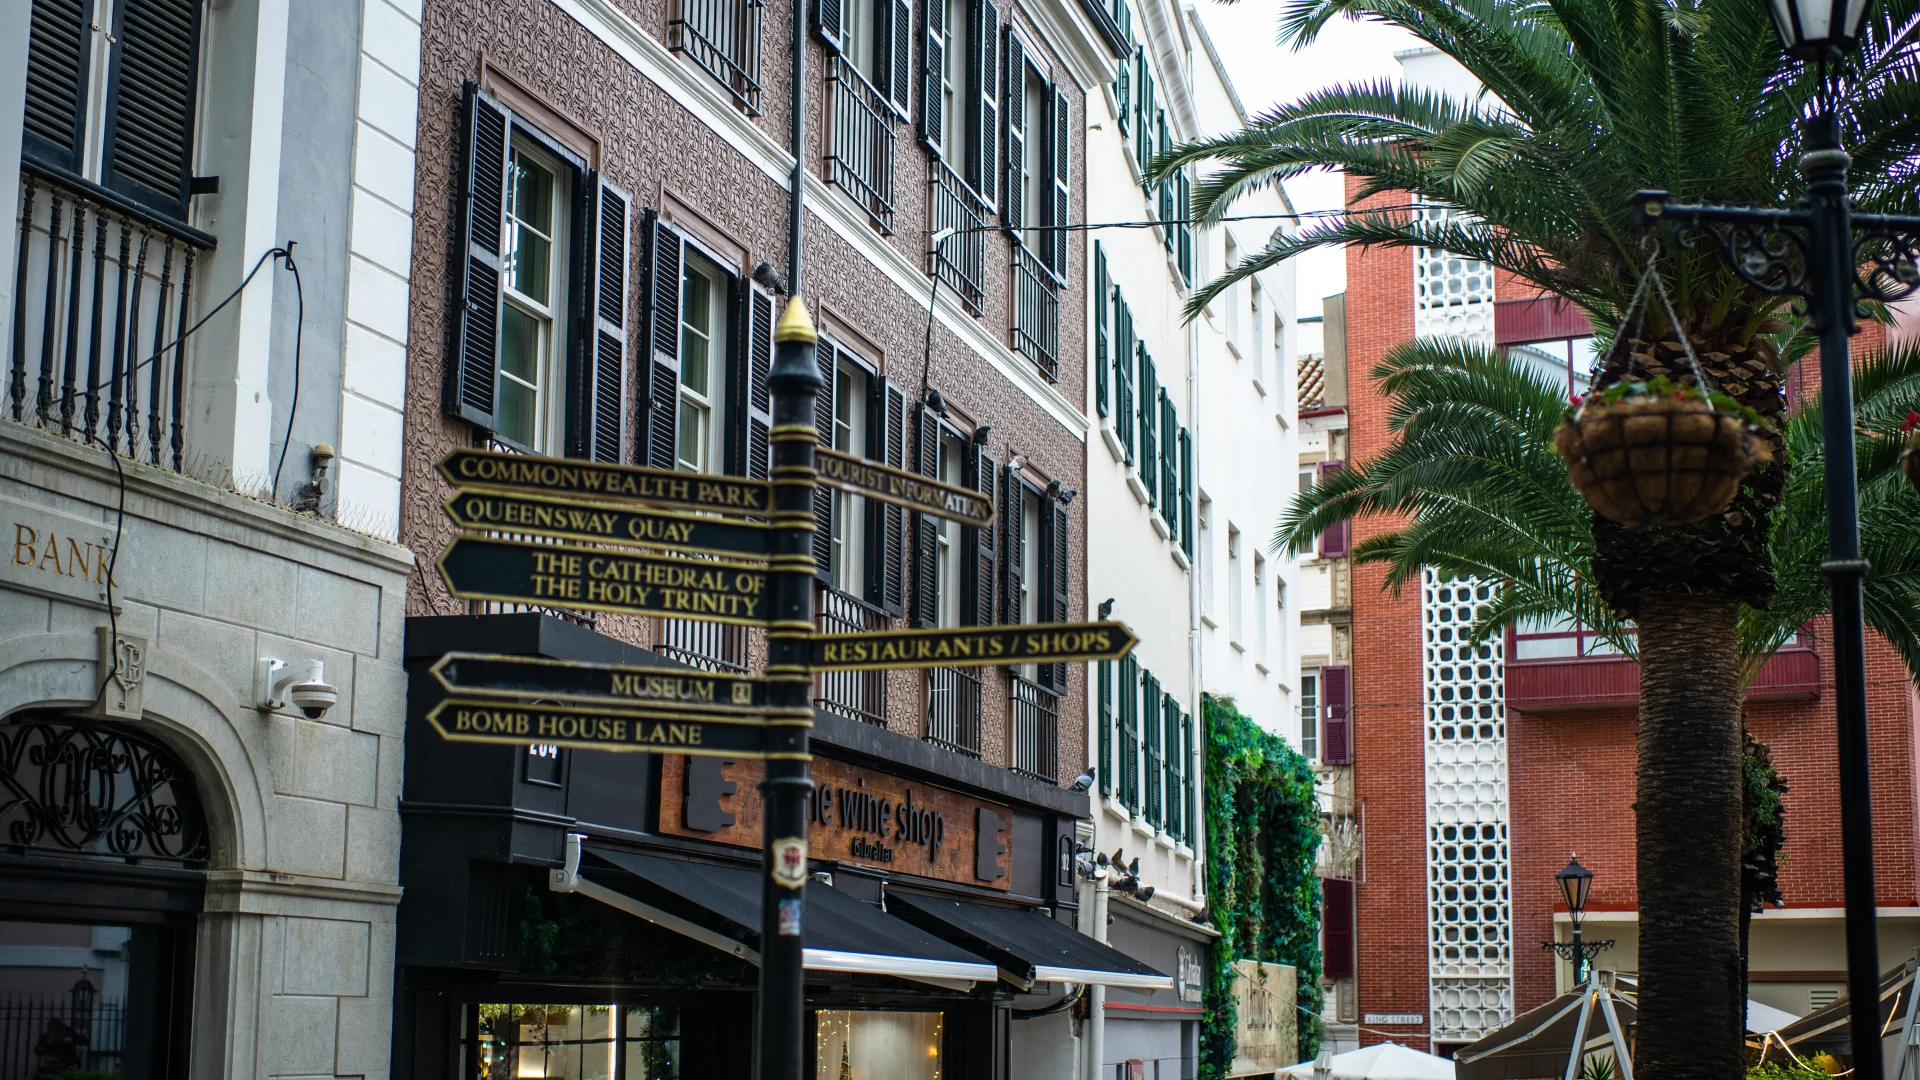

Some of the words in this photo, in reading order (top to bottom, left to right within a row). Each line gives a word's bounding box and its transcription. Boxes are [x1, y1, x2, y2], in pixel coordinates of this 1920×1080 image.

[459, 456, 688, 500] COMMONWEALTH
[697, 483, 760, 507] PARK
[820, 456, 884, 490] TOURIST
[888, 477, 987, 519] INFORMATION
[465, 499, 617, 534] QUEENSWAY
[628, 517, 695, 543] QUAY
[11, 522, 119, 589] BANK
[533, 552, 582, 578] THE
[588, 558, 727, 591] CATHEDRAL
[735, 574, 766, 594] OF
[531, 575, 581, 599] THE
[587, 583, 651, 606] HOLY
[660, 587, 759, 617] TRINITY
[823, 636, 1004, 663] RESTAURANTS
[1026, 630, 1111, 654] SHOPS
[611, 674, 715, 700] MUSEUM
[456, 710, 529, 735] BOMB
[537, 715, 627, 741] HOUSE
[635, 723, 703, 745] LANE
[838, 777, 892, 838] wine
[896, 788, 945, 864] shop
[1367, 1016, 1388, 1024] KING
[1390, 1016, 1421, 1024] STREET
